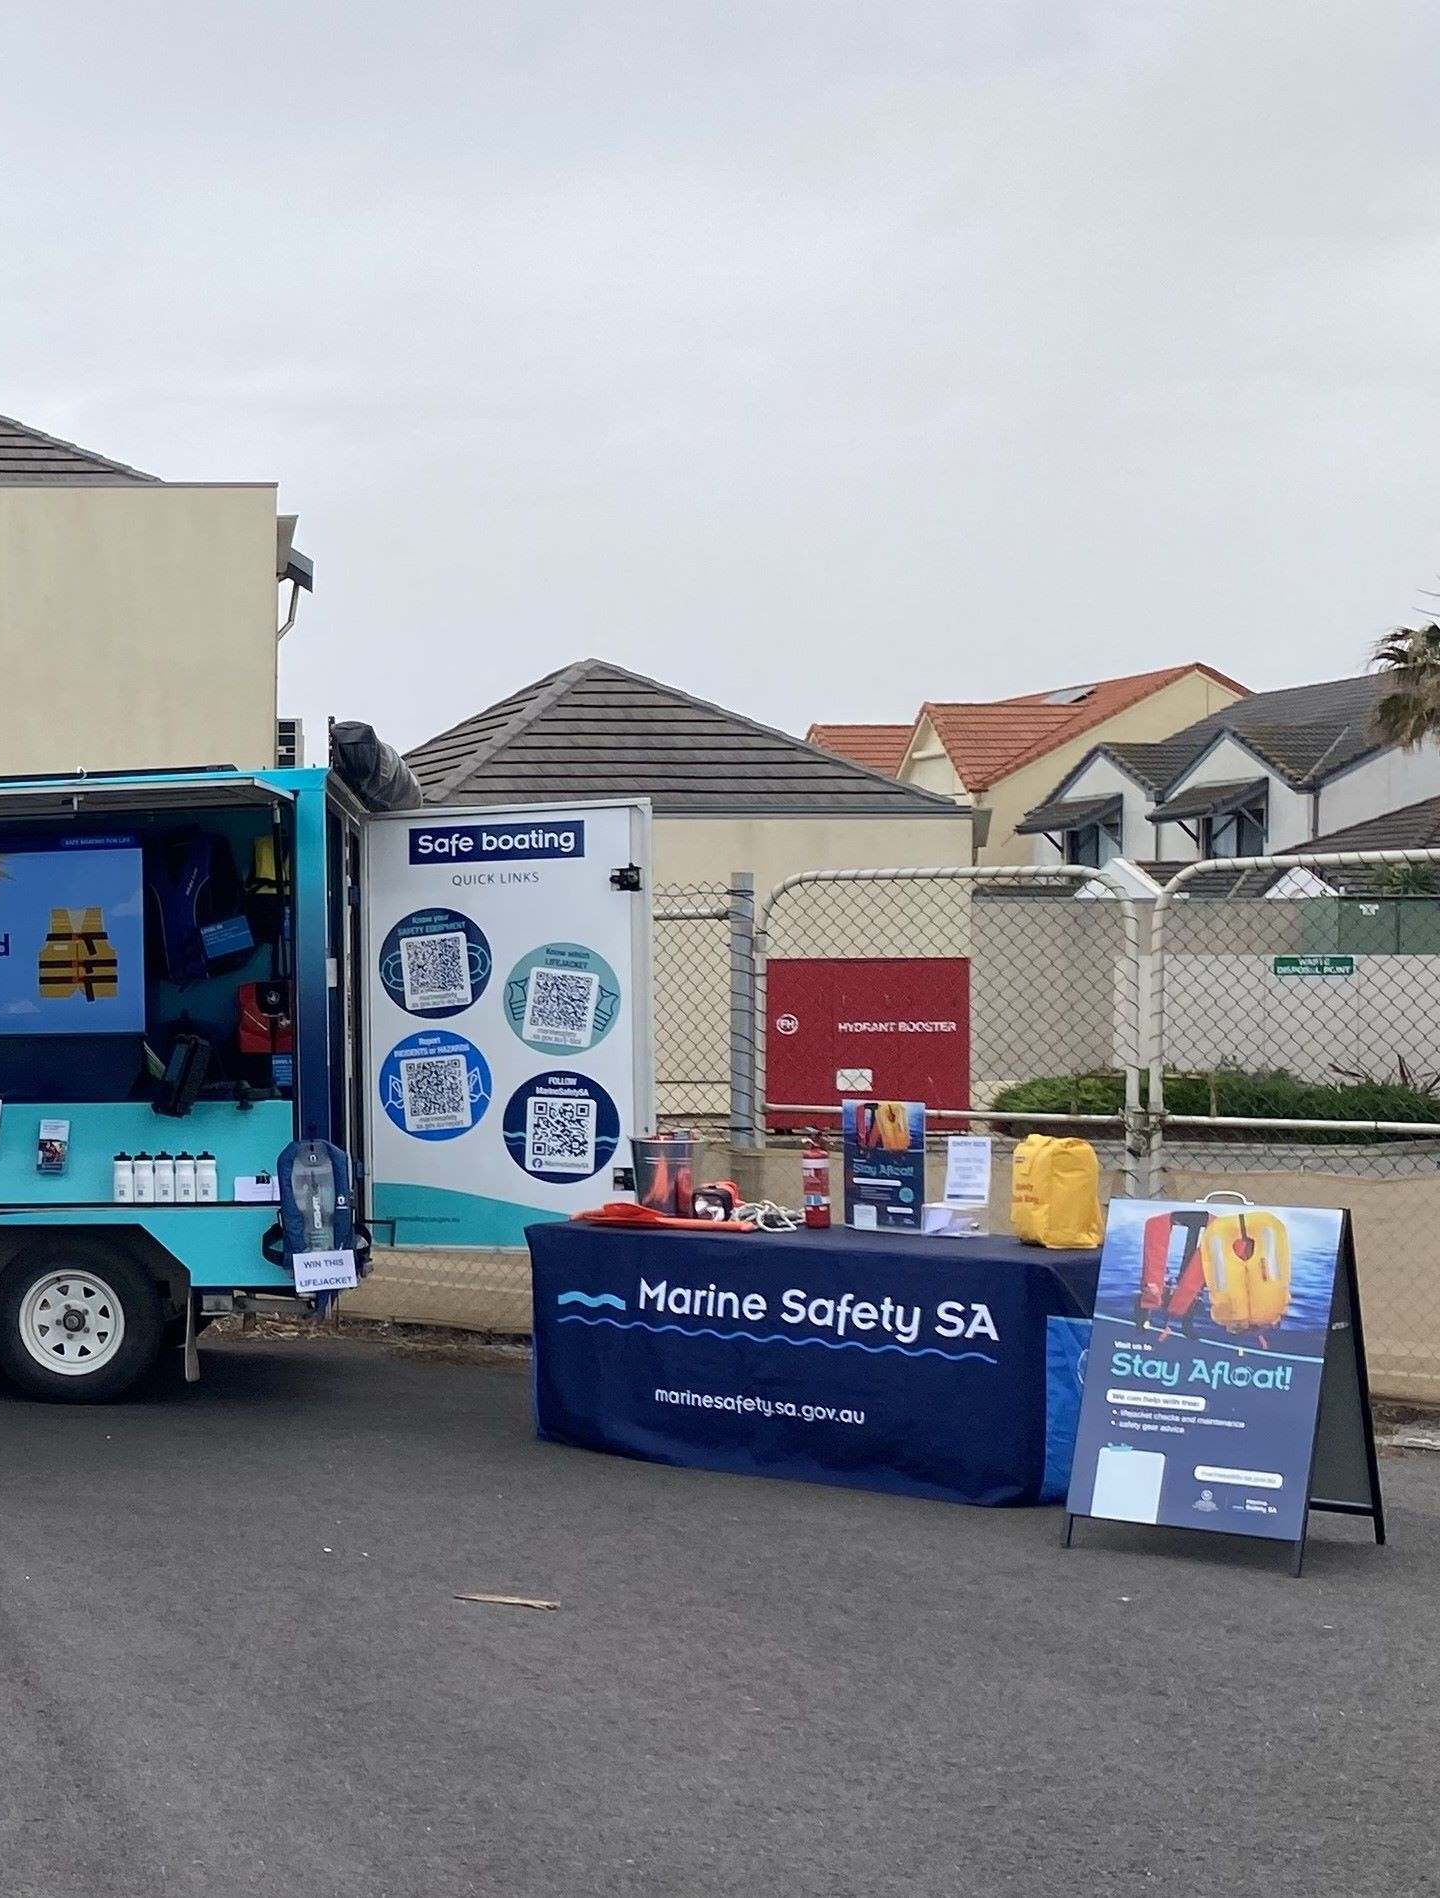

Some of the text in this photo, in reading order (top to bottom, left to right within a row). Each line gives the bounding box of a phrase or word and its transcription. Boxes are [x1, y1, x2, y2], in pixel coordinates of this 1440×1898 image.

[418, 829, 575, 856] Safe boating
[452, 872, 539, 886] QUICK LINKS
[838, 1021, 957, 1032] HYDRANT BOOSTER
[303, 1258, 344, 1269] WIN THIS
[299, 1276, 353, 1288] LIFEJACKET
[639, 1276, 1000, 1343] Marine Safety SA
[1111, 1352, 1292, 1391] Stay Afloat!
[655, 1387, 865, 1425] marinesafety.sa.gov.au
